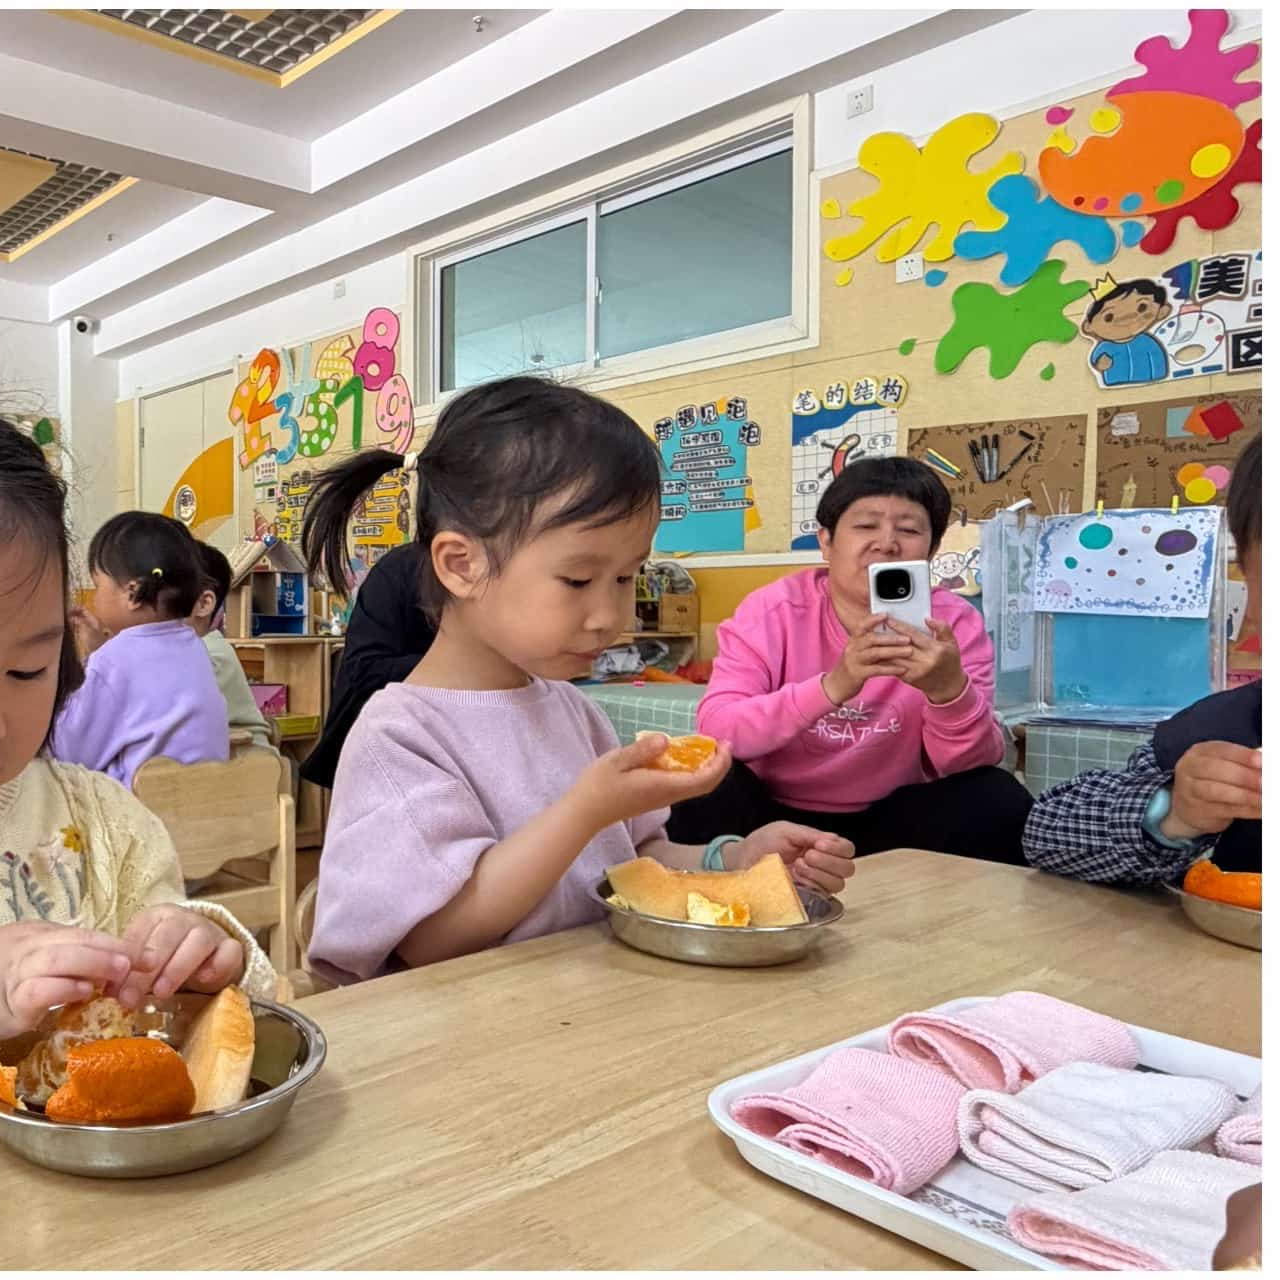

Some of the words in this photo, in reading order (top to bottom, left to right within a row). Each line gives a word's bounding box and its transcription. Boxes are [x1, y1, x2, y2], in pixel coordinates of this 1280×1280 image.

[1198, 258, 1246, 299] 美
[795, 377, 903, 412] 笔的结构
